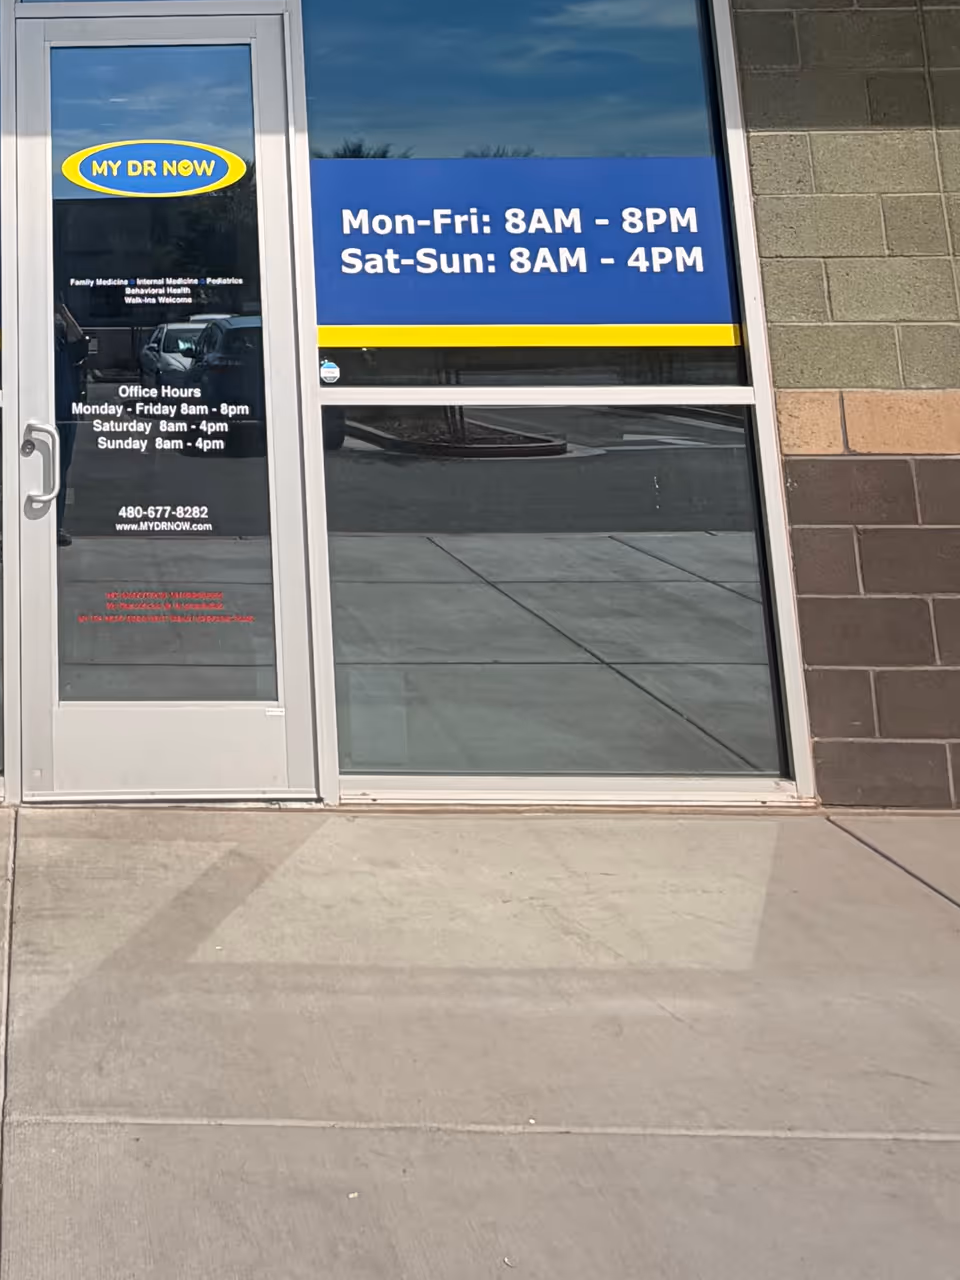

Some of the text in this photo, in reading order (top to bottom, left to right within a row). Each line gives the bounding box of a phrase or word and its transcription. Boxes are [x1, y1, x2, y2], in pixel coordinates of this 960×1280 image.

[91, 159, 216, 177] MY DR NOW
[341, 206, 699, 235] Mon-Fri: 8AM - 8PM
[340, 246, 705, 274] Sat-Sun: 8AM - 4PM
[70, 278, 95, 287] Family
[125, 287, 191, 295] Behavioral Health
[159, 296, 193, 304] Welcome
[118, 385, 202, 398] Office Hours
[71, 402, 124, 417] Monday
[135, 402, 177, 417] Friday
[180, 403, 209, 415] 8am
[220, 403, 250, 418] 8pm
[92, 419, 152, 435] Saturday
[159, 420, 188, 433] 8am
[199, 420, 229, 435] 4pm
[97, 437, 148, 452] Sunday
[155, 437, 184, 450] 8am
[195, 437, 225, 452] 4pm
[118, 505, 209, 519] 480-677-8282
[115, 521, 213, 531] www.MYDRNOW.com
